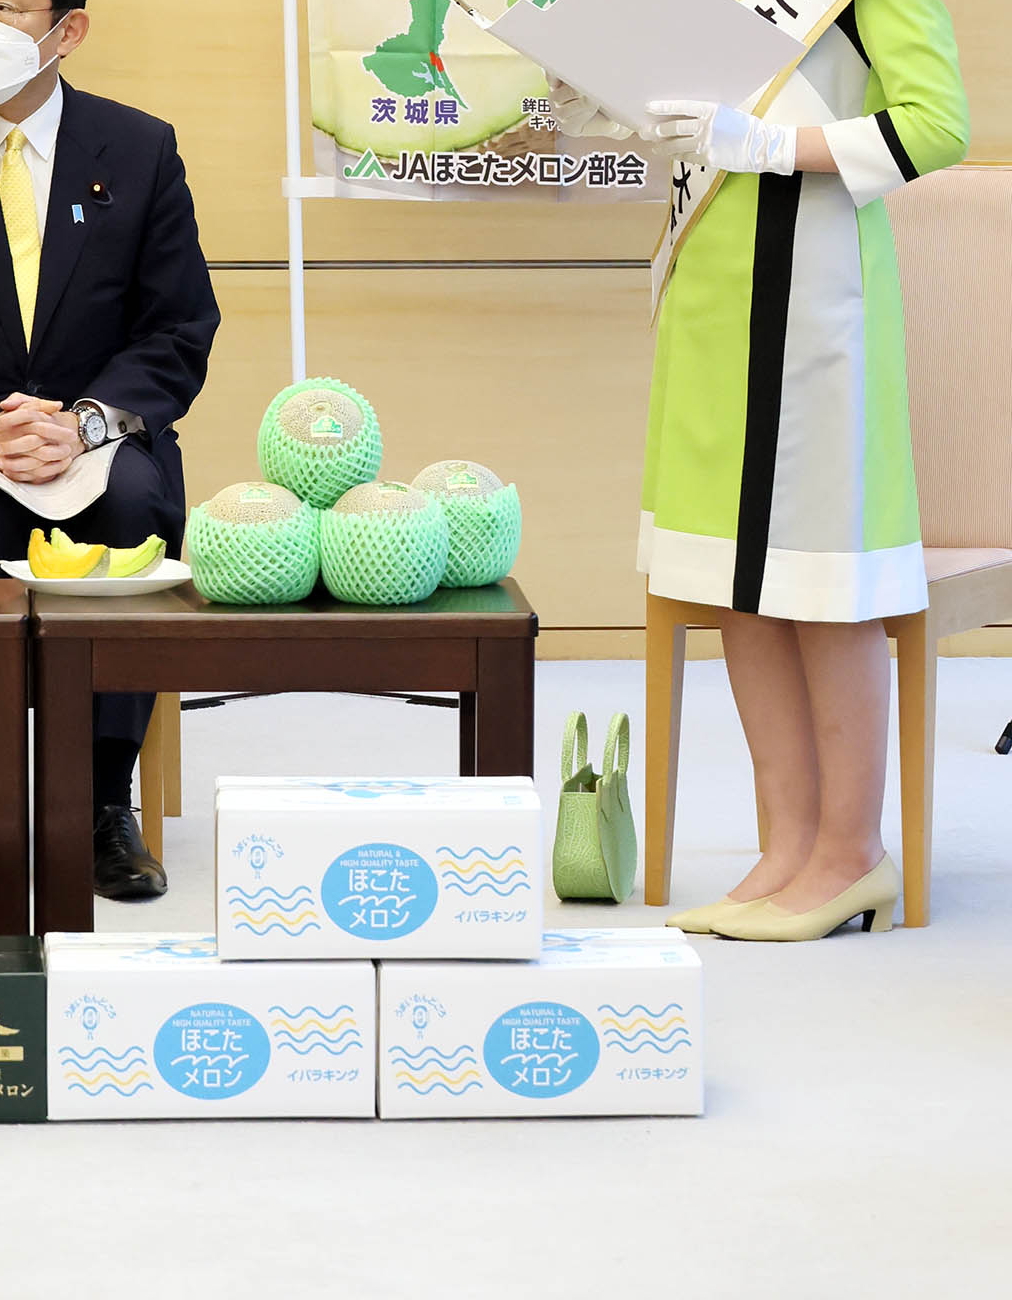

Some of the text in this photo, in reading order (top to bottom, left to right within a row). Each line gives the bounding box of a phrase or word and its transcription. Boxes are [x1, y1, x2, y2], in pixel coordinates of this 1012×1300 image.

[371, 98, 459, 125] 茨城県
[530, 115, 562, 130] キャ
[392, 153, 646, 187] JAほこたメロン部会
[349, 868, 411, 892] ほこた
[349, 908, 410, 928] メロン
[454, 910, 527, 923] イバラキング
[181, 1028, 243, 1052] ほこた
[511, 1027, 572, 1050] ほこた
[181, 1068, 242, 1088] メロン
[287, 1069, 359, 1082] イバラキング
[511, 1067, 572, 1087] メロン
[616, 1067, 688, 1080] イバラキング
